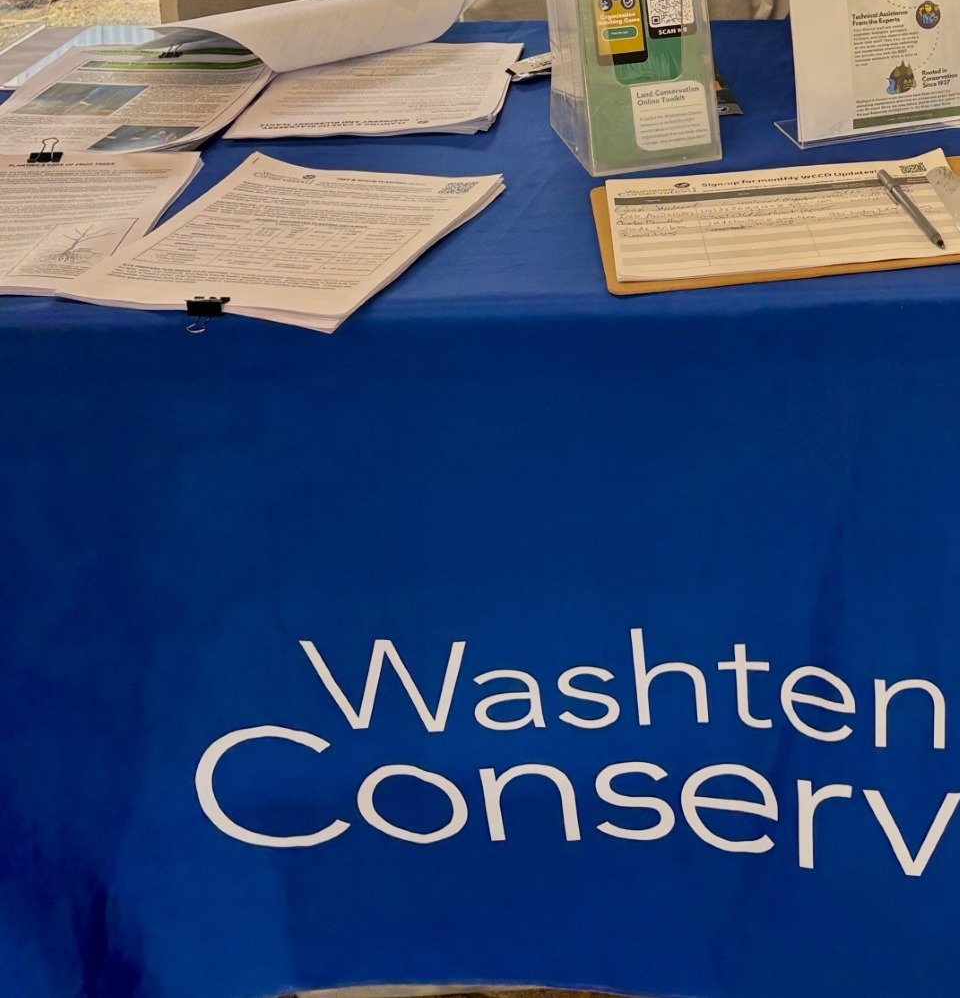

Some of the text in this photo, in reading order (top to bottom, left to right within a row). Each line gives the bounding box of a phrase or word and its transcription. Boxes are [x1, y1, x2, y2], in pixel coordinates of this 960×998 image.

[922, 73, 958, 82] Conservation
[655, 86, 699, 96] Conservation
[702, 180, 740, 188] Sign-up
[757, 176, 798, 184] monthly
